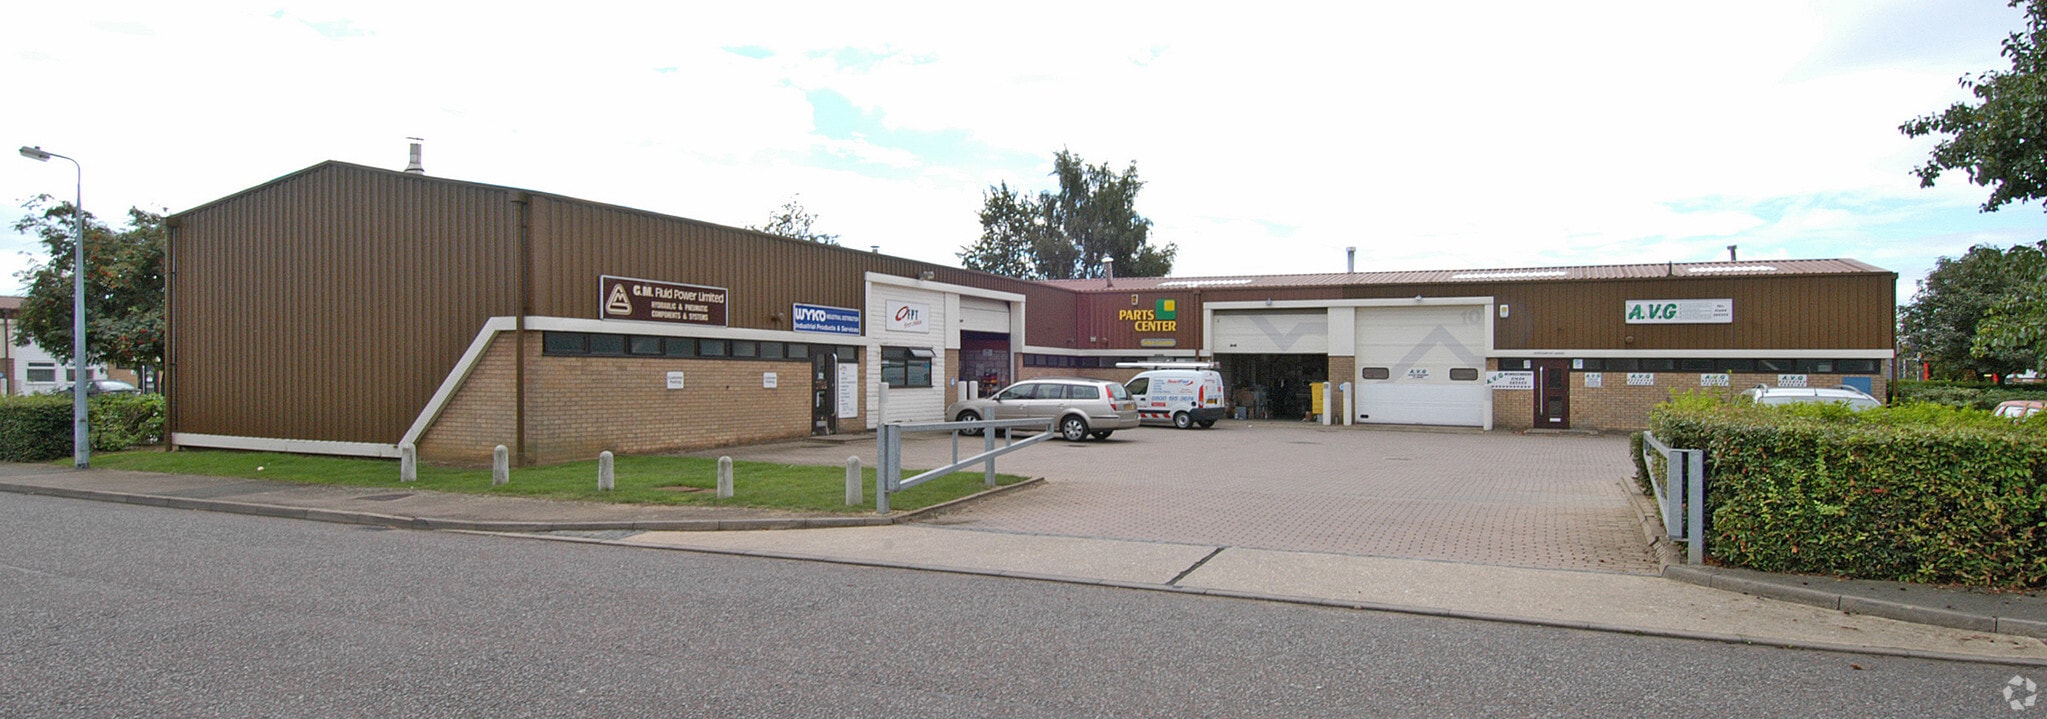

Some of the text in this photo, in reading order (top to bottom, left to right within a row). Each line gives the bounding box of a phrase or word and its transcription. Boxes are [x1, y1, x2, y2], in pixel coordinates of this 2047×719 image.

[632, 285, 724, 304] G.M. Fluid Power Limited
[678, 303, 683, 311] &
[1628, 303, 1677, 320] A.V.G
[682, 312, 688, 320] &
[795, 308, 827, 322] WYKO
[1119, 309, 1155, 321] PARTS
[795, 322, 816, 330] Industrial
[816, 323, 836, 332] Products
[841, 325, 859, 333] Services
[1134, 320, 1177, 332] CENTER
